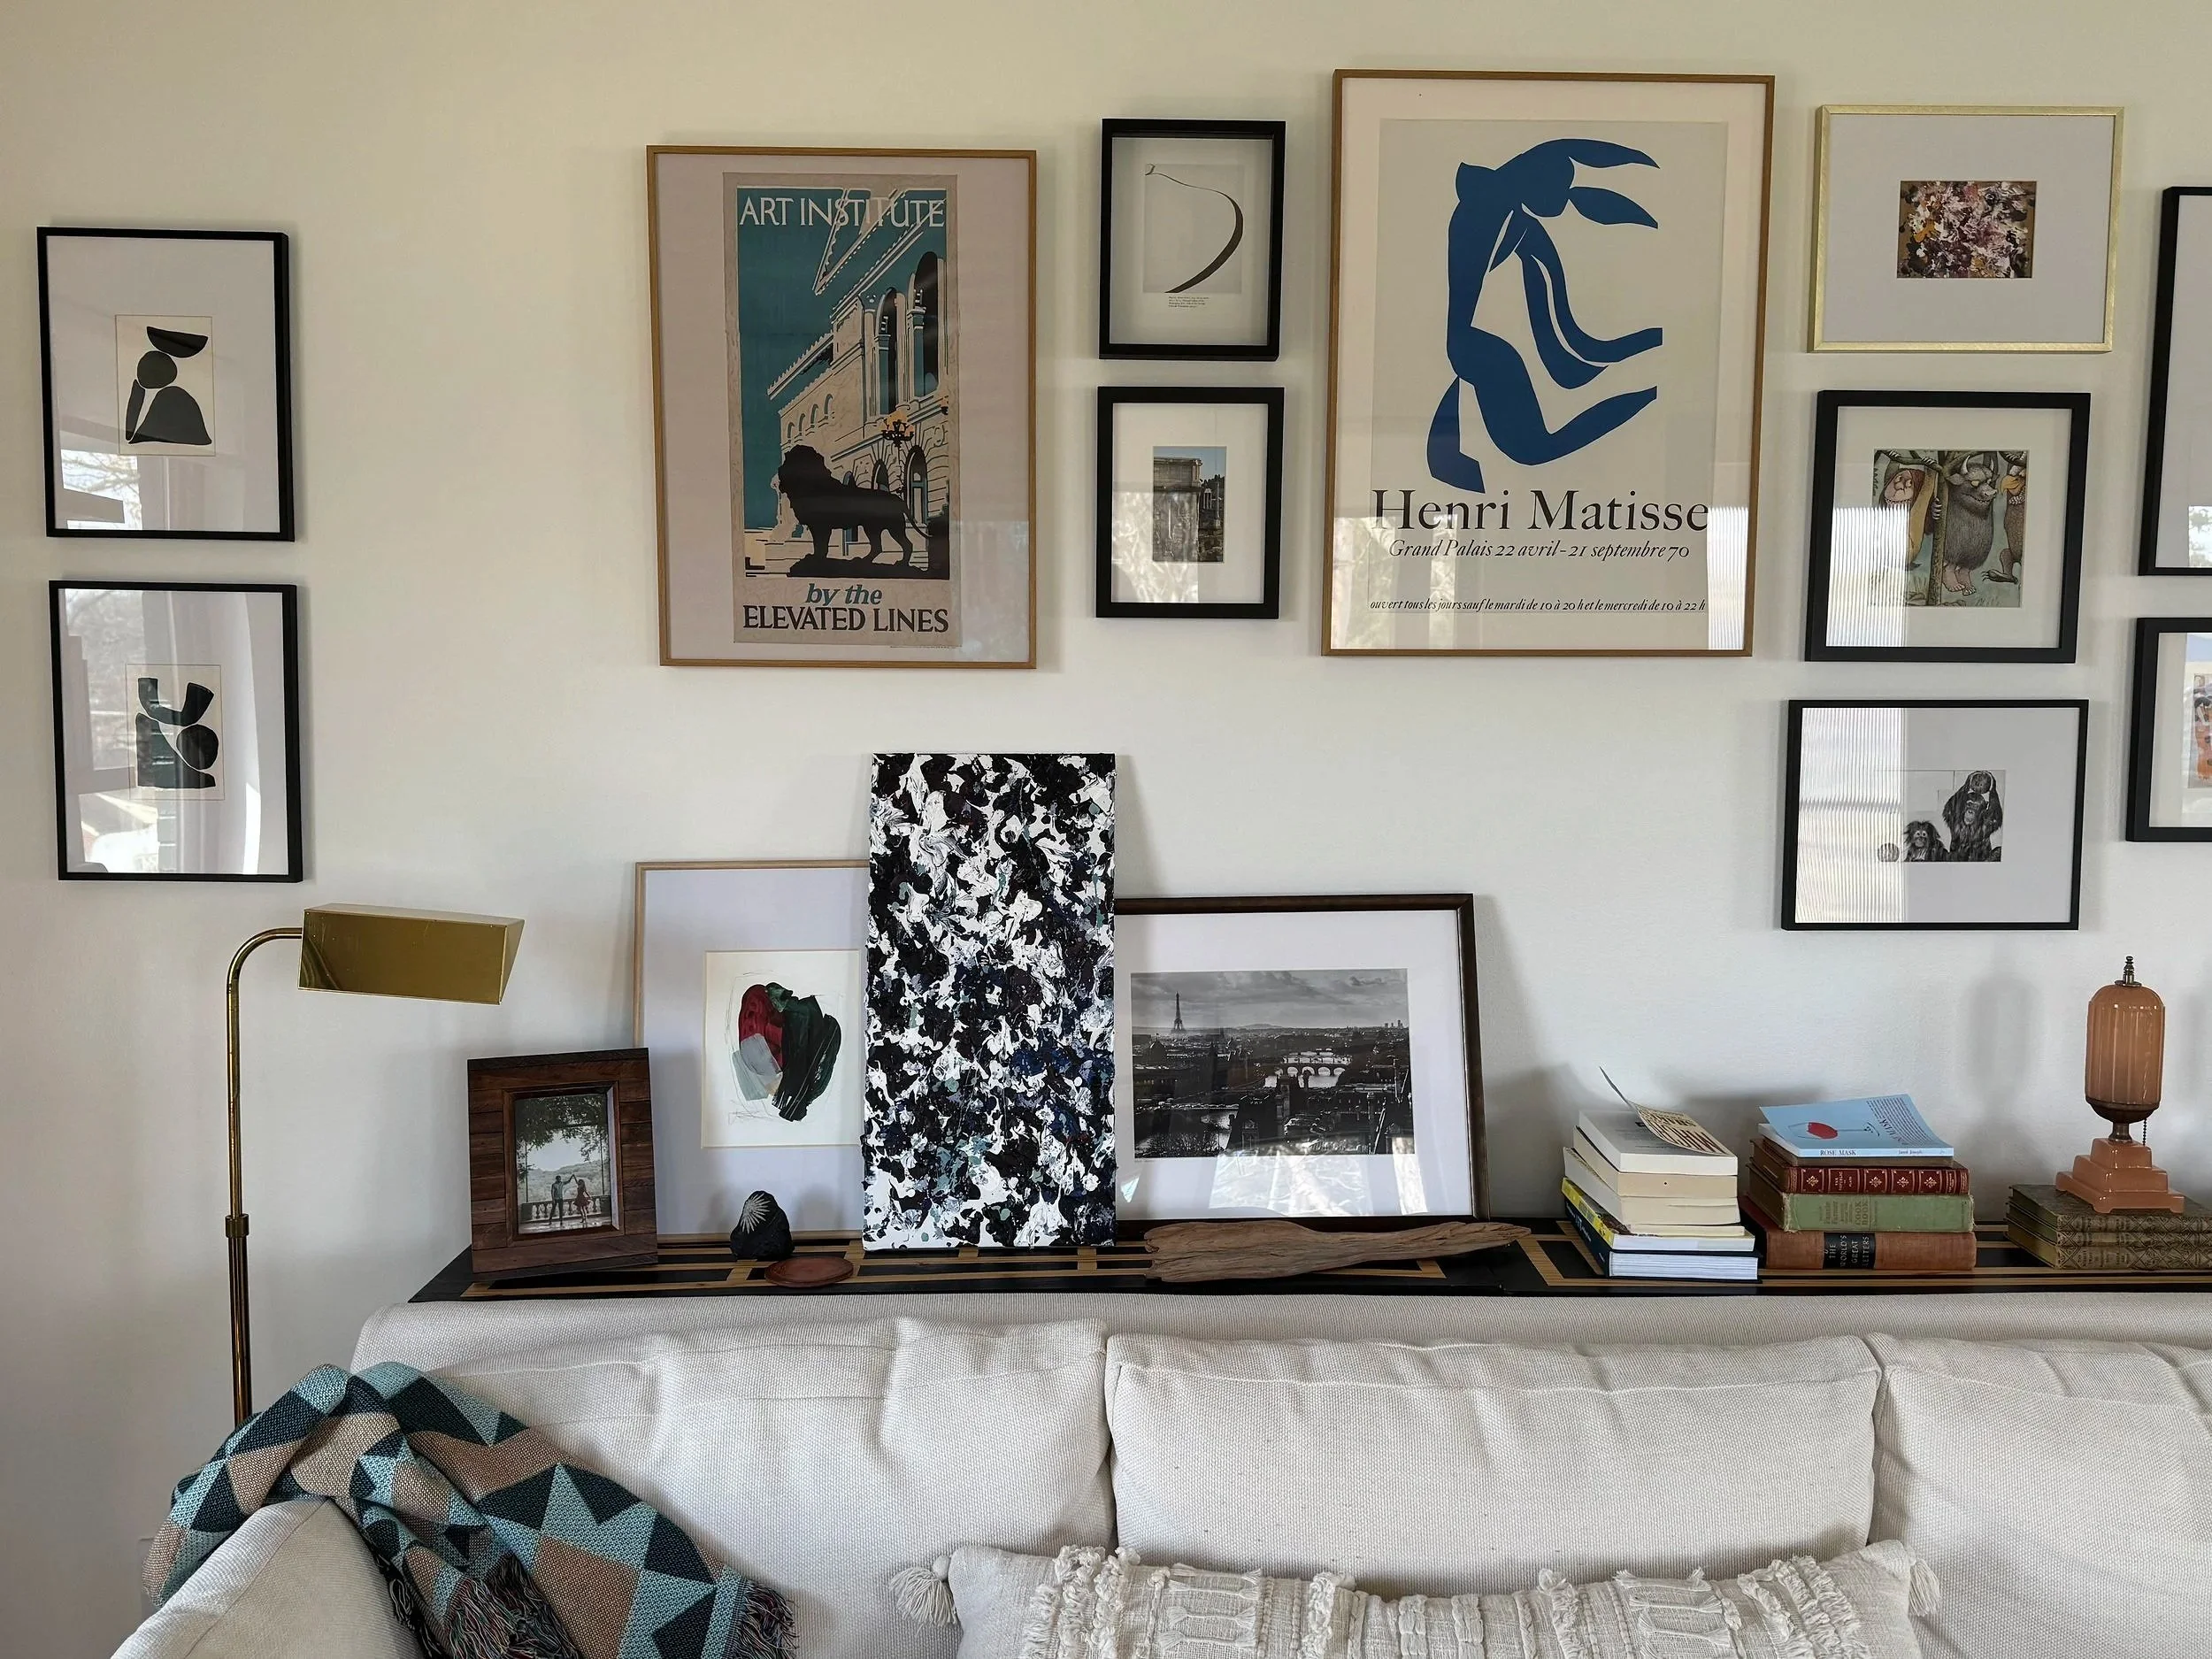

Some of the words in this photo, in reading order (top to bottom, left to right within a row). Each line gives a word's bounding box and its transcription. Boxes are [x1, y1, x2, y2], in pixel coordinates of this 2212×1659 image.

[739, 196, 795, 227] ART
[800, 196, 945, 227] INSTITUTE
[1371, 489, 1509, 530] Henri
[1527, 489, 1709, 531] Matisse
[1389, 539, 1443, 557] Grand
[1444, 539, 1493, 557] Palais
[1494, 546, 1516, 557] 22
[1590, 541, 1666, 562] septembre
[1667, 546, 1690, 562] 70
[805, 583, 841, 606] by
[844, 584, 883, 605] the
[1370, 600, 1402, 610] ouvert
[1403, 600, 1424, 610] tous
[1424, 598, 1437, 610] les
[1435, 598, 1462, 612] jours
[1463, 598, 1486, 612] sauf
[1486, 599, 1494, 610] le
[1494, 599, 1526, 611] mardi
[1526, 599, 1538, 611] de
[1554, 600, 1560, 611] à
[1584, 601, 1594, 611] et
[1594, 600, 1603, 611] le
[1603, 600, 1647, 611] mercredi
[1648, 600, 1659, 611] de
[1675, 600, 1682, 611] à
[1698, 599, 1706, 611] h
[742, 605, 866, 631] ELEVATED
[873, 608, 949, 633] LINES
